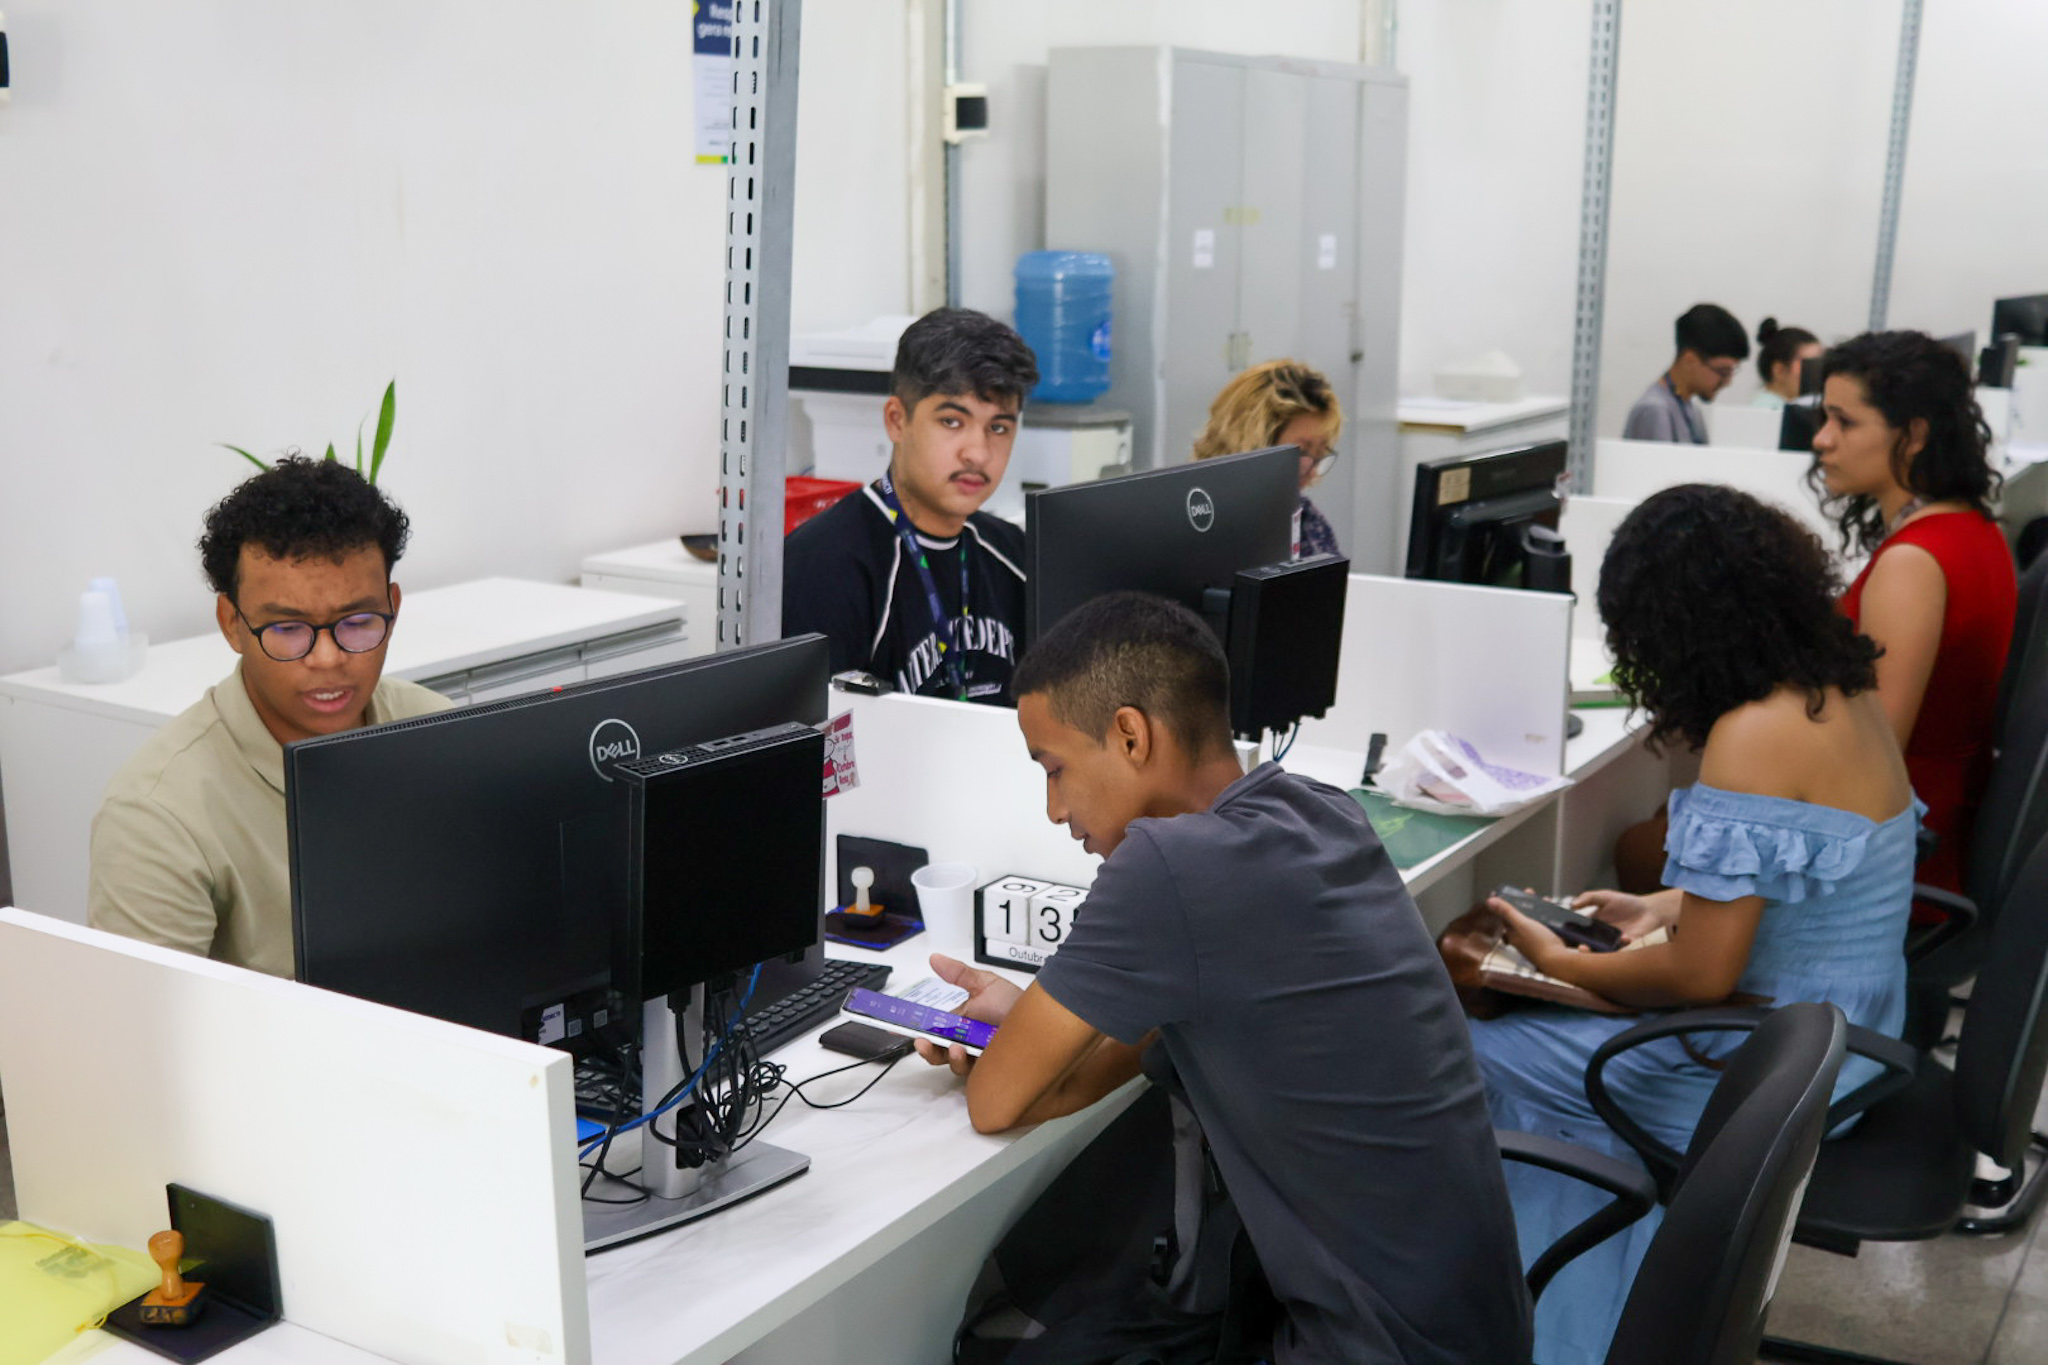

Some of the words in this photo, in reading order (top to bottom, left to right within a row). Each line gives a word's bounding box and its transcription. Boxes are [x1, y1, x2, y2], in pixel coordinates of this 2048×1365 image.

[1191, 503, 1212, 517] DELL
[596, 739, 637, 762] DELL
[999, 899, 1011, 935] 1
[1039, 906, 1062, 942] 3
[1009, 947, 1044, 963] Outubr
